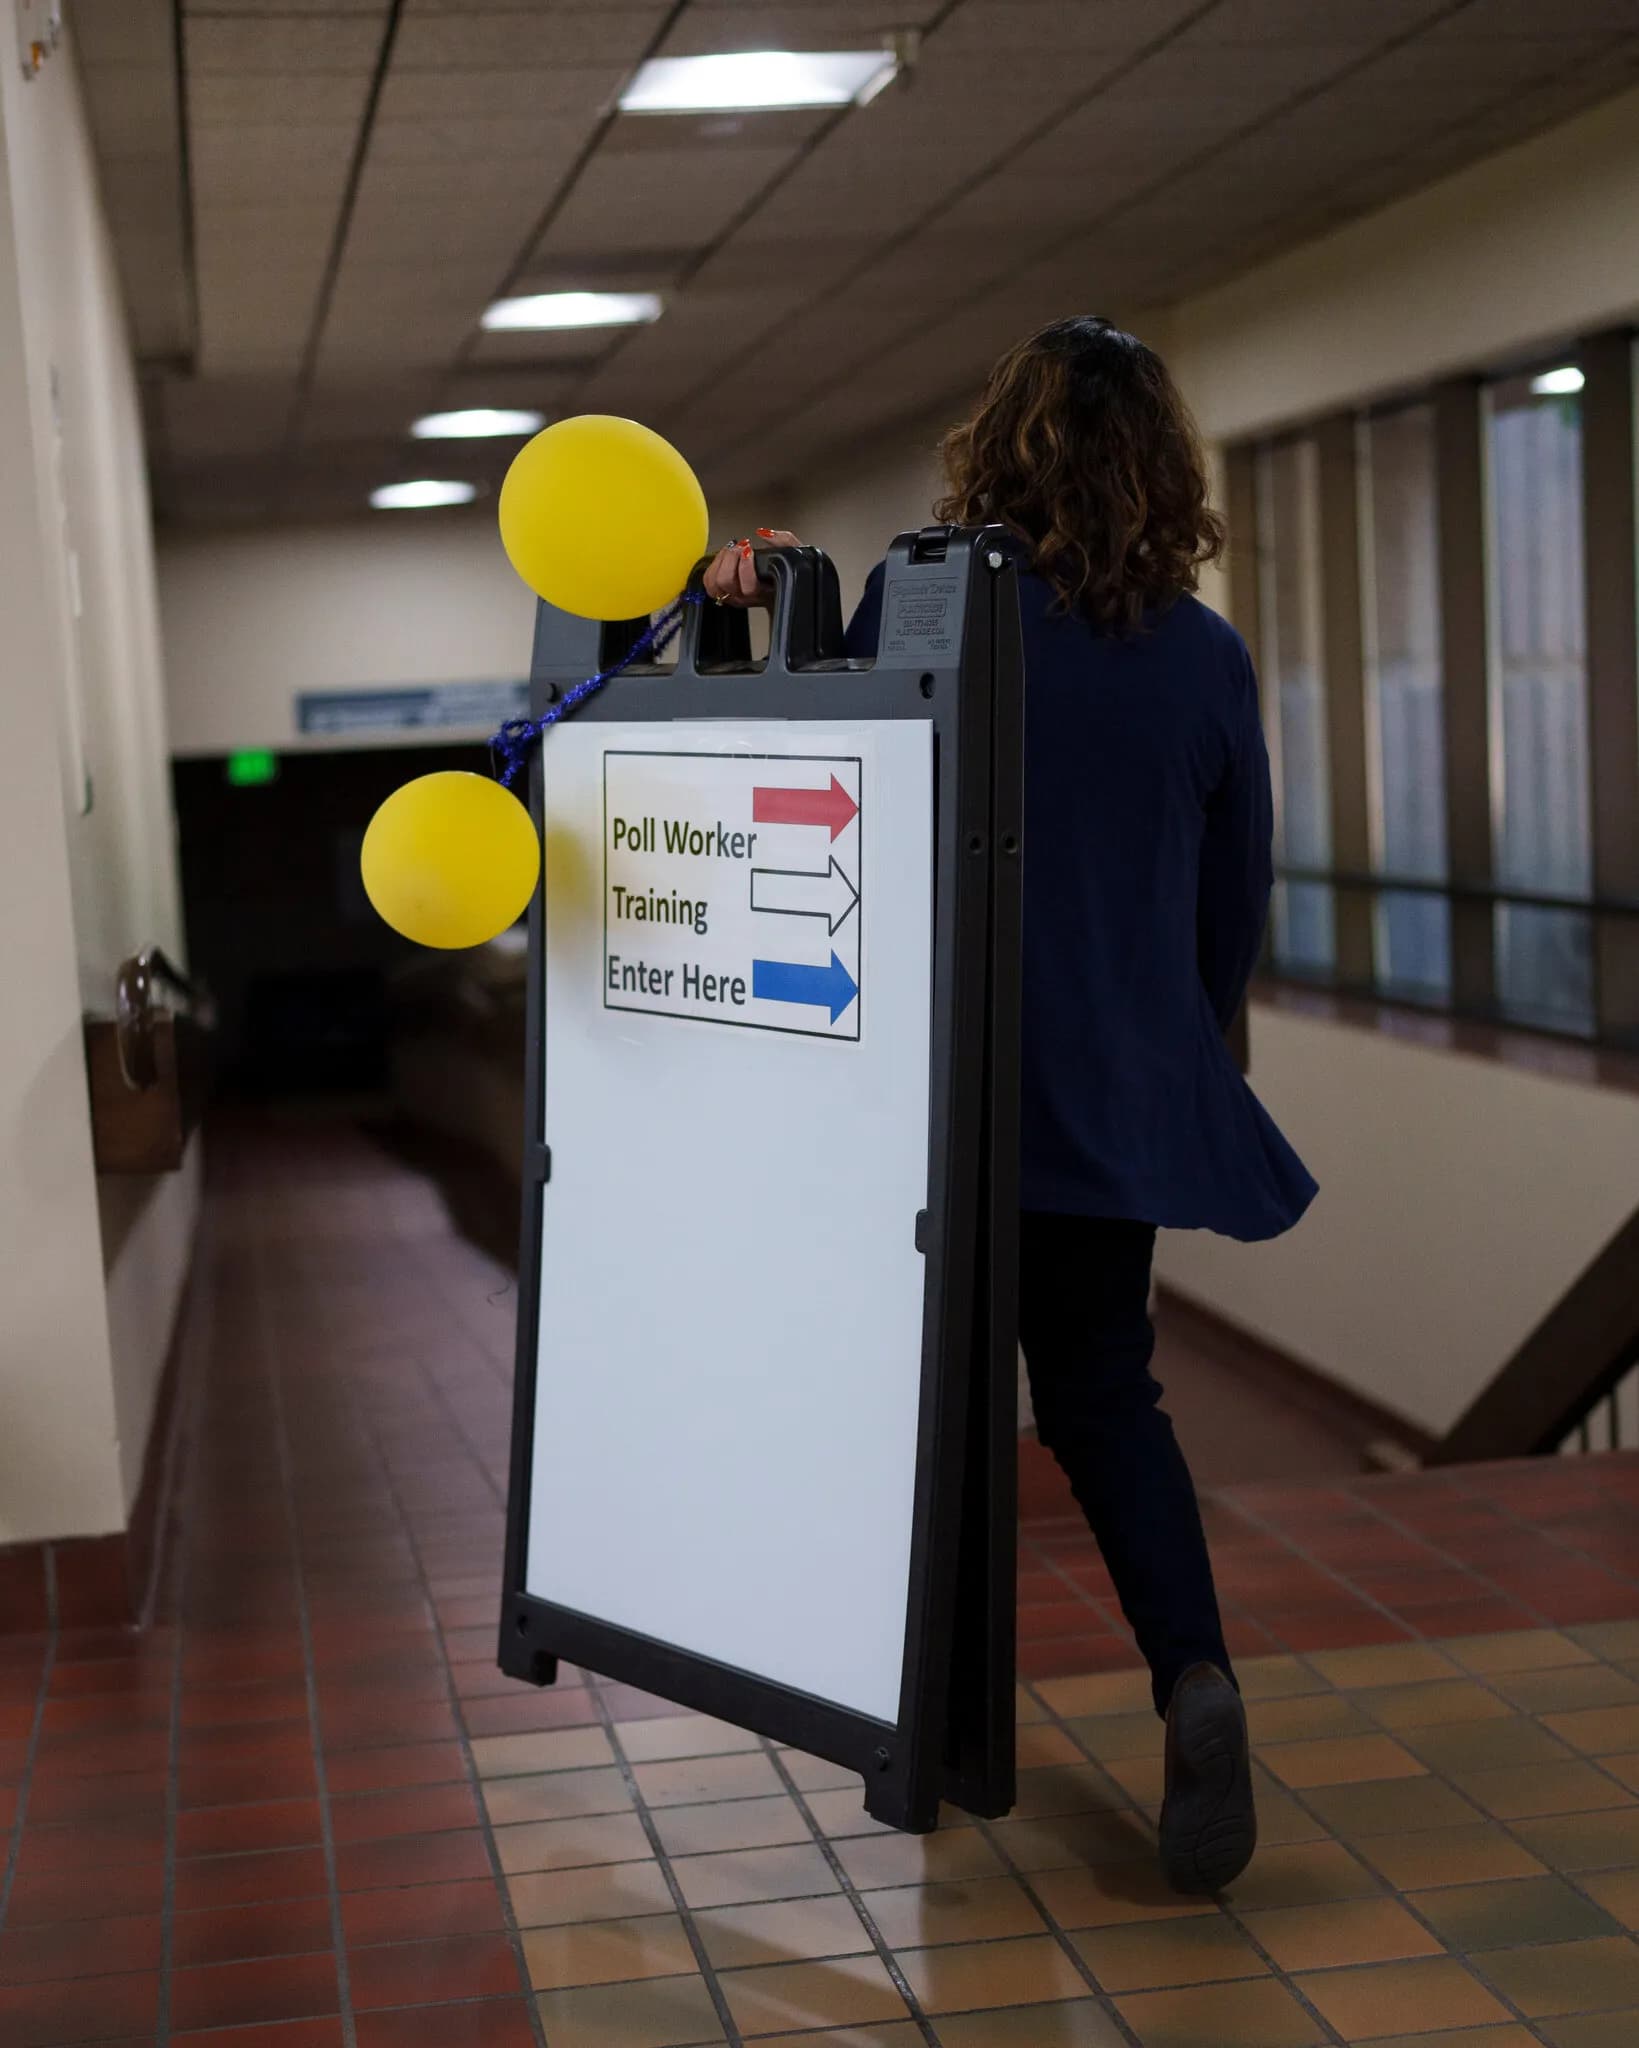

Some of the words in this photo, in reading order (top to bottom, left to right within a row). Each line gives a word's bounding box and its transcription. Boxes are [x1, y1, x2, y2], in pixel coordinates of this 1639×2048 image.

[613, 817, 655, 853] Poll
[663, 820, 757, 859] Worker
[612, 886, 708, 935] Training
[608, 955, 674, 997] Enter
[683, 963, 746, 1006] Here
